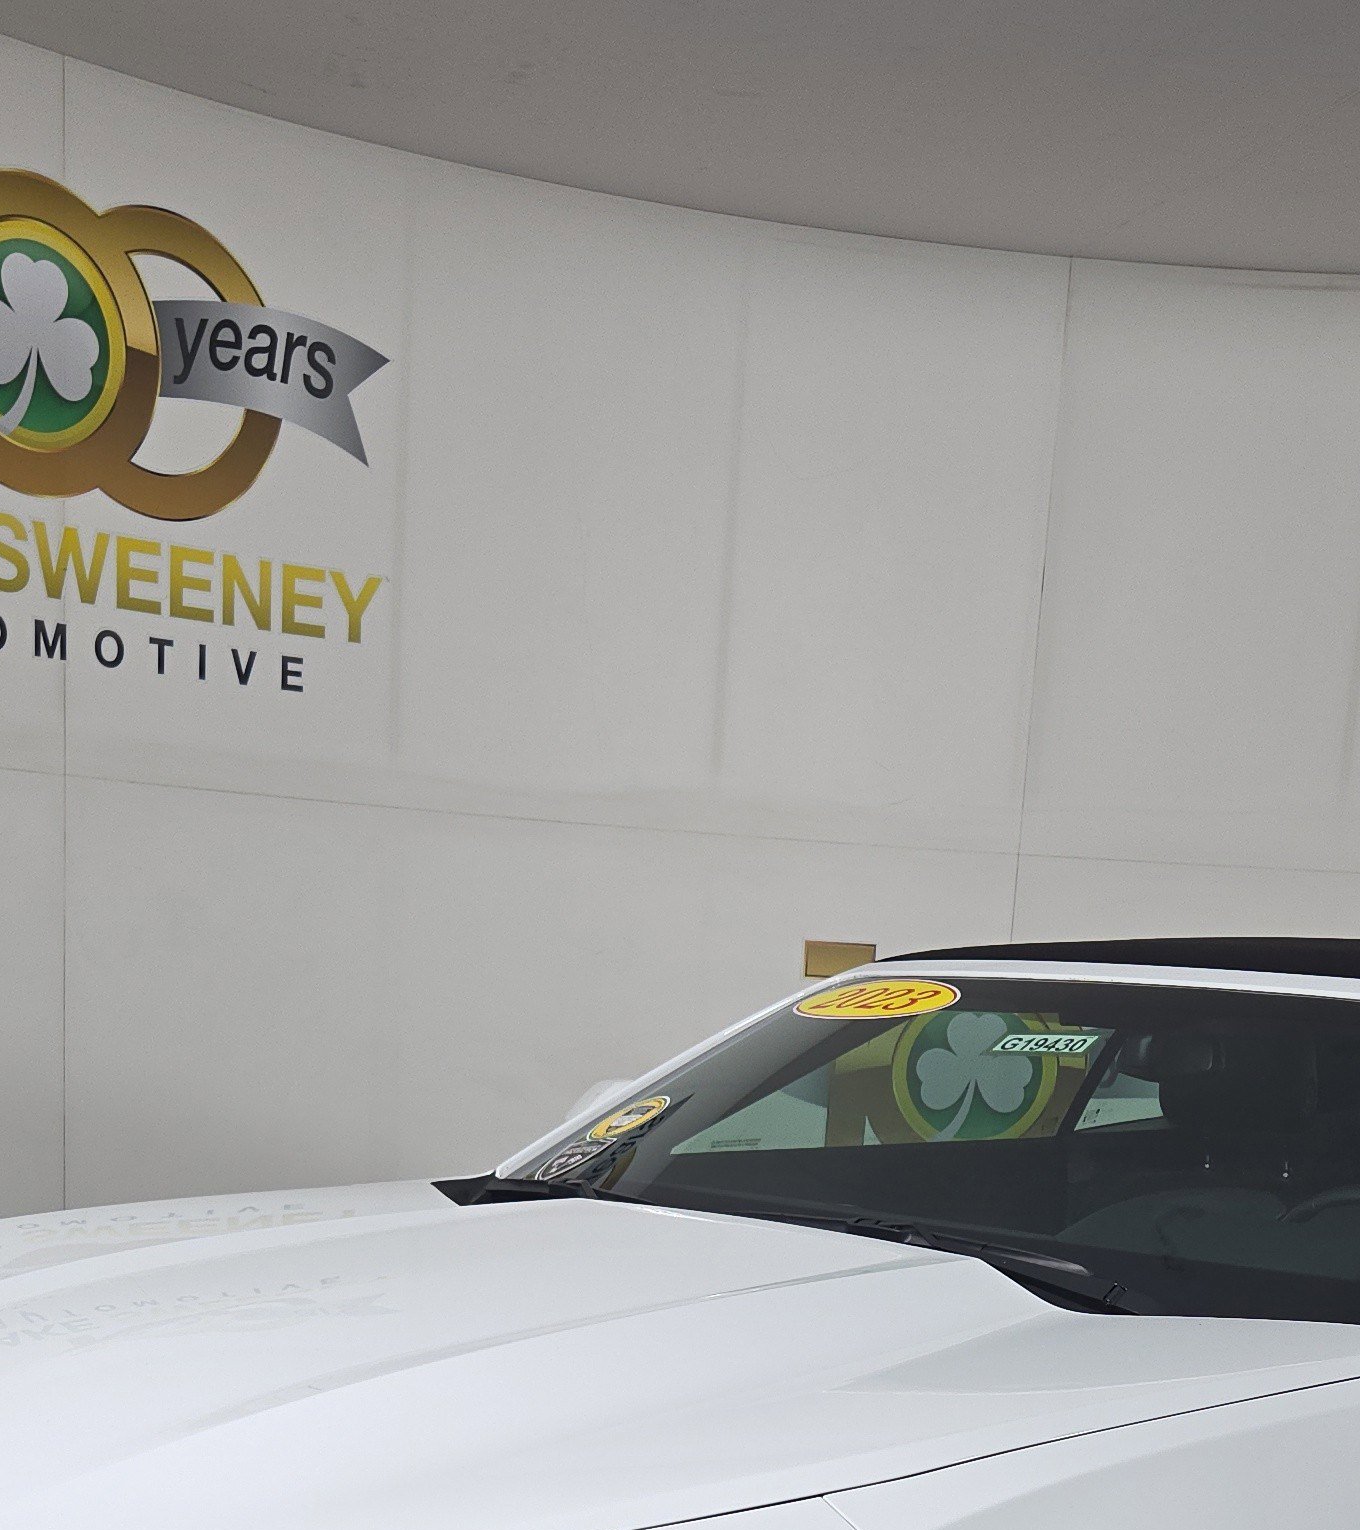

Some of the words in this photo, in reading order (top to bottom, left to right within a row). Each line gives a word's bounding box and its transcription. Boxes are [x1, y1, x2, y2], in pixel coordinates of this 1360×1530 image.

[172, 315, 337, 401] years
[810, 986, 942, 1011] 2023
[1001, 1036, 1087, 1052] G19430
